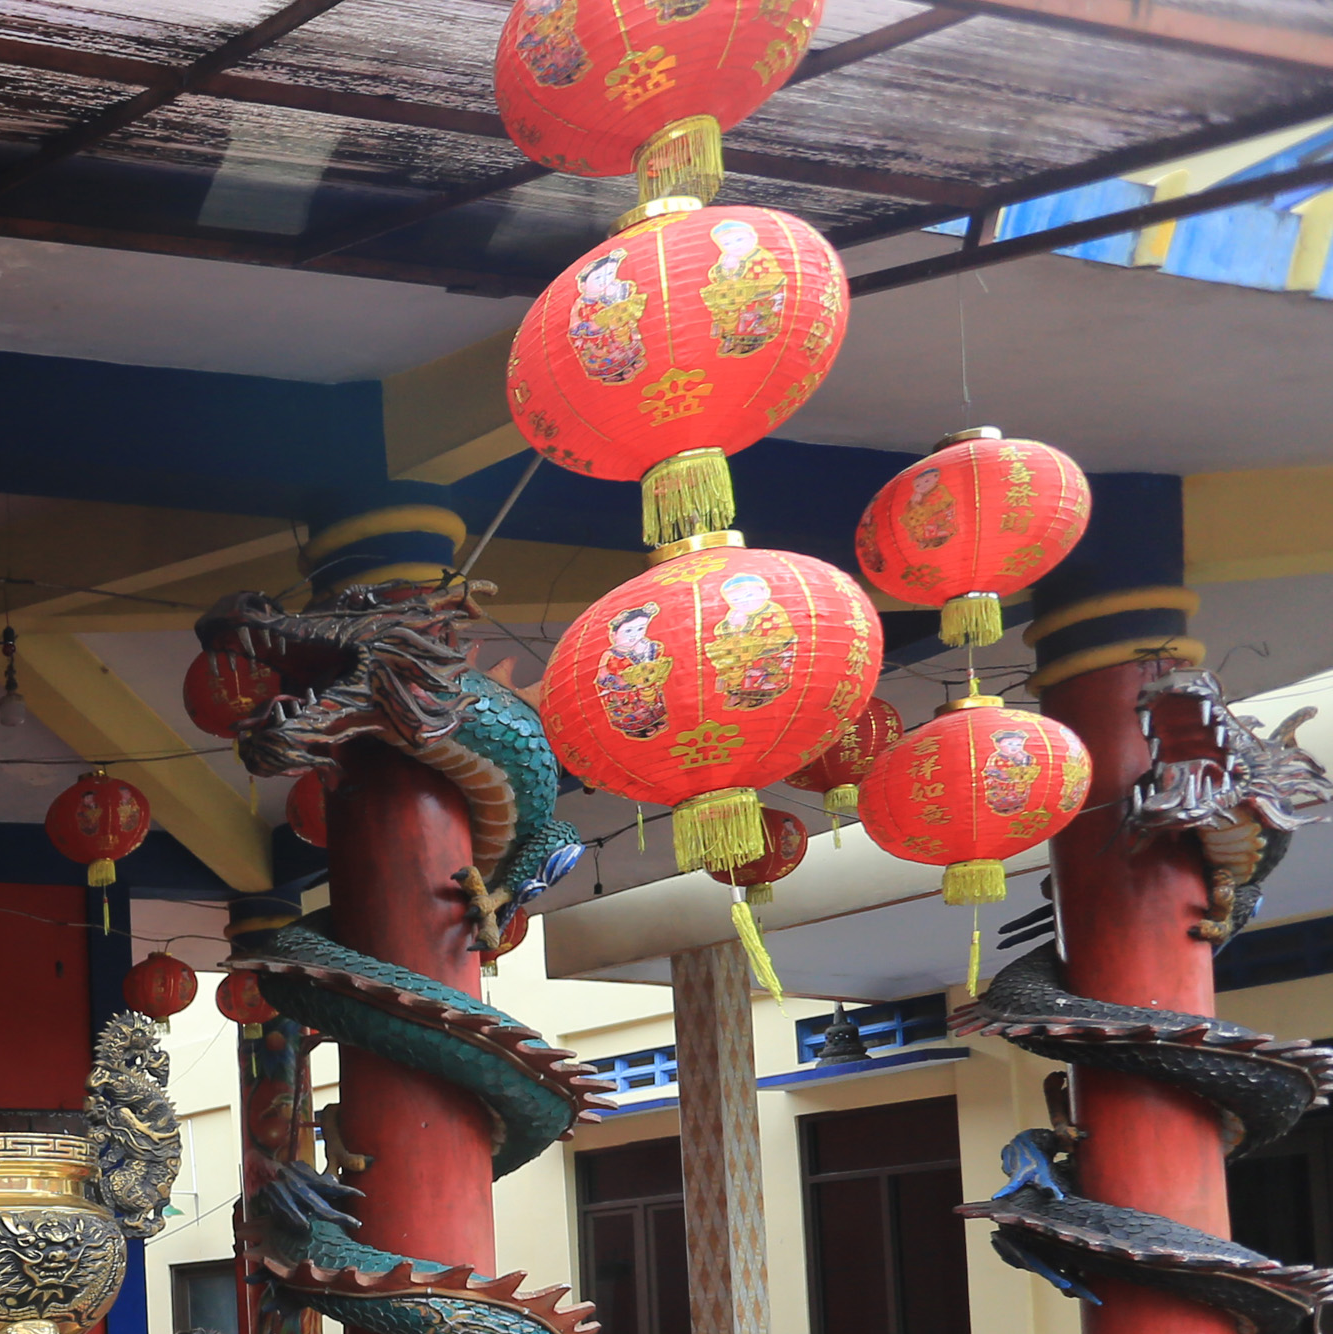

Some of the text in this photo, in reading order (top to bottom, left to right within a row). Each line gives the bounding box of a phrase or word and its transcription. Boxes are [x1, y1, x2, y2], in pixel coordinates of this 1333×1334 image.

[997, 445, 1040, 535] 恭喜發財
[822, 569, 873, 721] 恭喜發財
[906, 736, 953, 825] 吉祥如意
